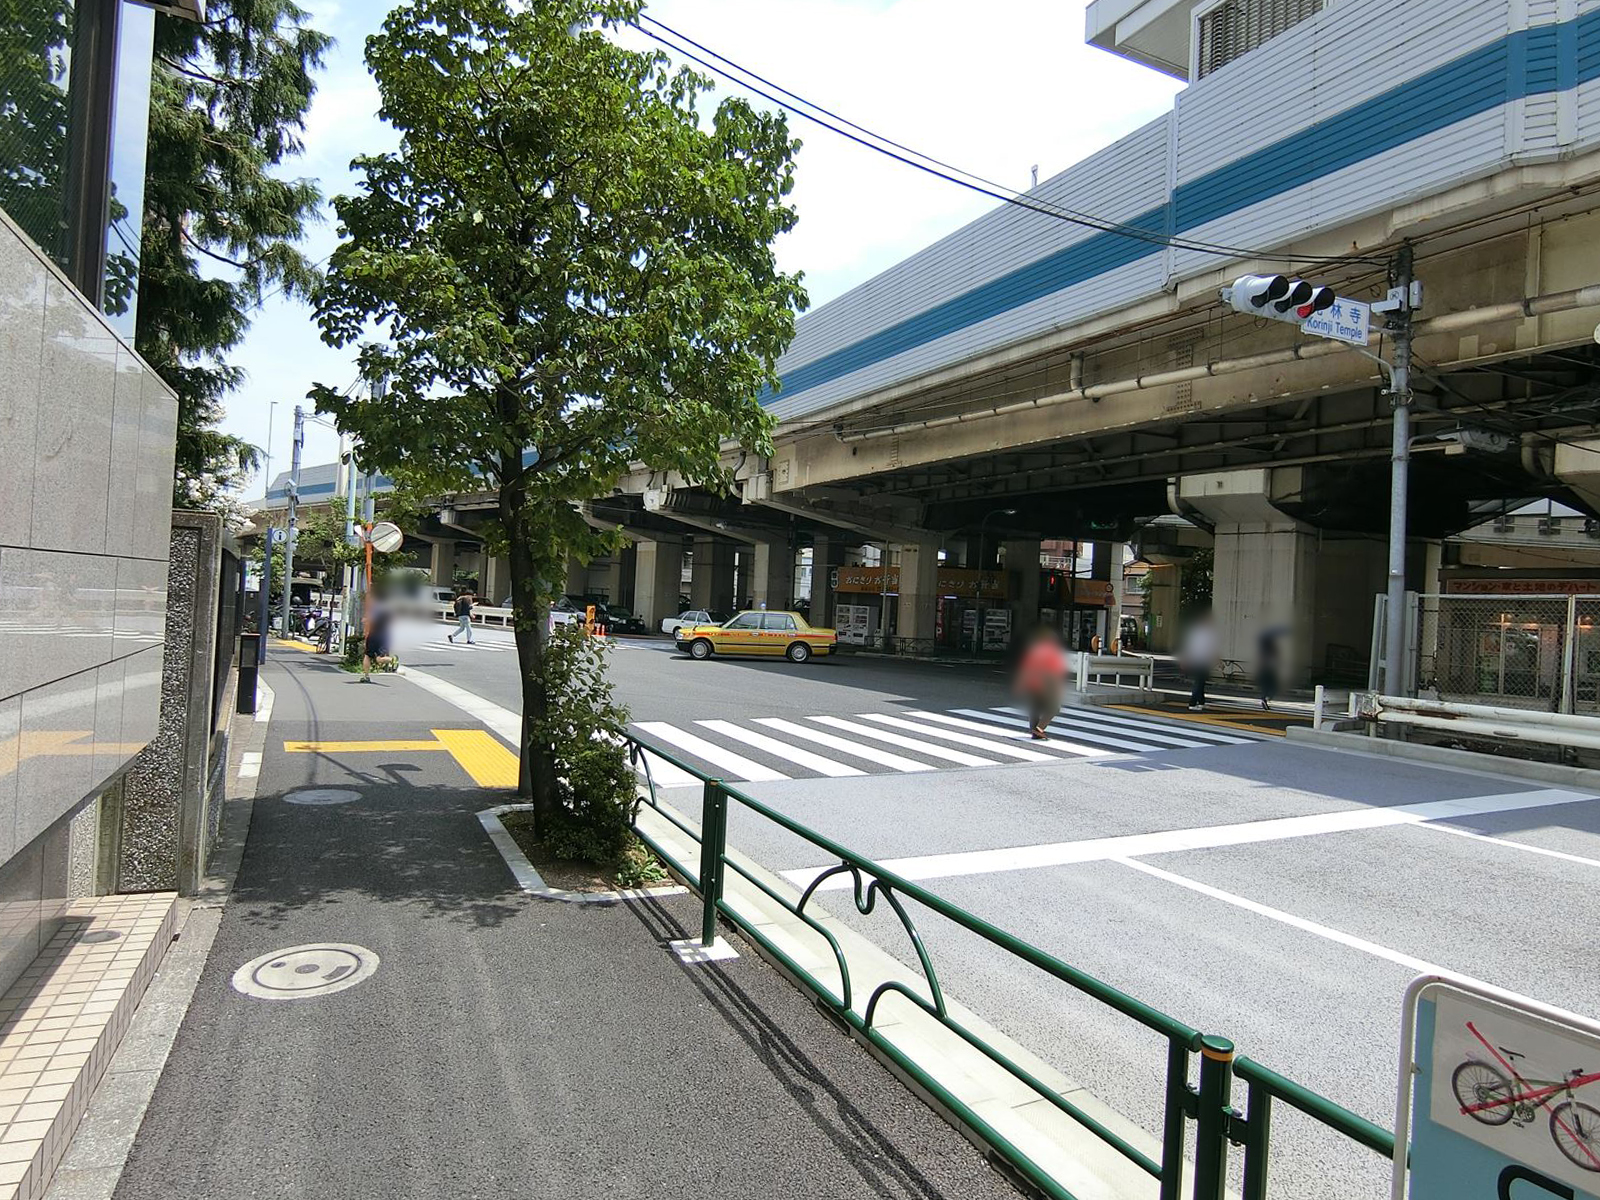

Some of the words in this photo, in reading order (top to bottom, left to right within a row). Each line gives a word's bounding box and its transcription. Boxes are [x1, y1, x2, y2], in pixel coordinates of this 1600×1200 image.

[1316, 303, 1362, 324] 林寺
[1307, 316, 1333, 334] Korinji
[1335, 321, 1363, 339] Temple
